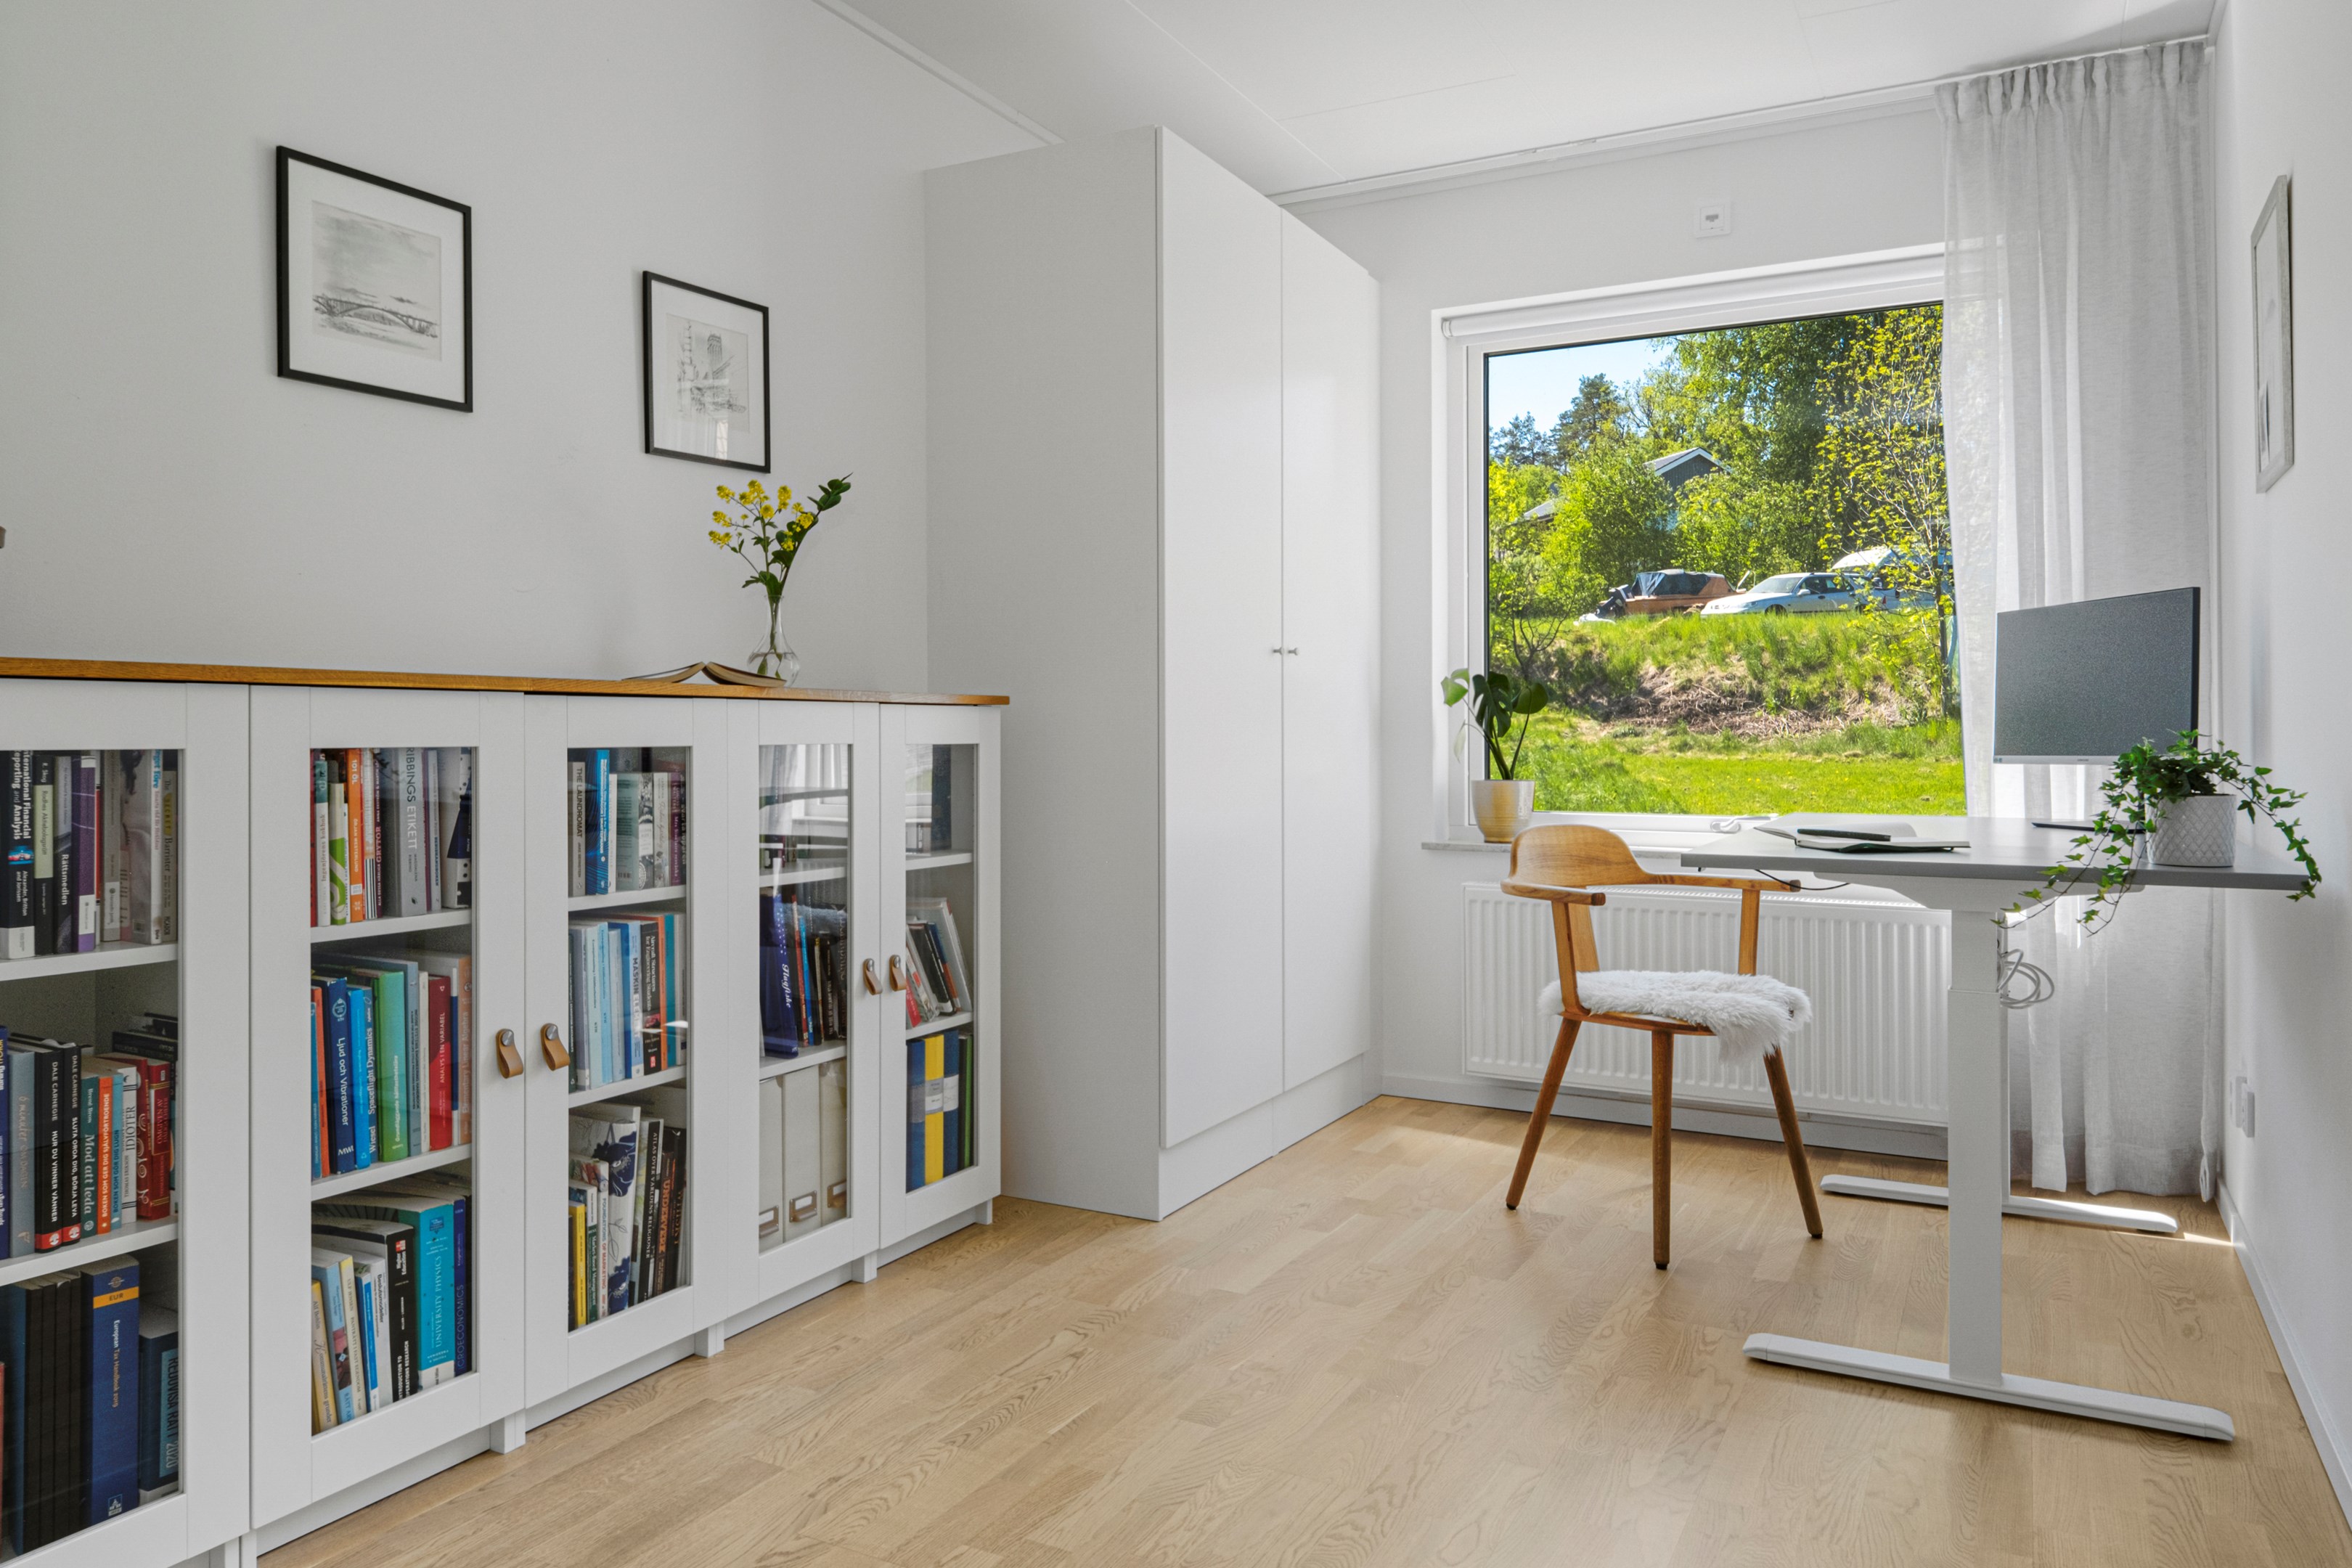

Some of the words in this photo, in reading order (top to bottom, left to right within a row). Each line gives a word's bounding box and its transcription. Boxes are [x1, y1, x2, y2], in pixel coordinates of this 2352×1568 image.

[12, 750, 23, 789] eporting
[407, 748, 416, 803] RIBBINGS
[12, 804, 23, 840] Analysis
[23, 802, 31, 839] Financial
[407, 805, 417, 849] ETIKETT
[164, 837, 173, 872] Barrister
[61, 854, 70, 906] Rättsmedlen
[781, 963, 792, 1008] Flugfiske
[336, 1037, 346, 1058] Ljud
[365, 1028, 375, 1068] Dynamics
[439, 1044, 445, 1053] EN
[339, 1077, 349, 1126] Vibrationer
[367, 1070, 377, 1115] Spaceflight
[125, 1106, 136, 1151] IDIOTER
[52, 1148, 58, 1159] DU
[85, 1133, 96, 1163] Mod
[85, 1164, 94, 1184] att
[84, 1186, 95, 1214] leda
[659, 1179, 671, 1254] UNDERVERK
[602, 1242, 607, 1251] OF
[109, 1292, 123, 1302] EUR
[113, 1319, 121, 1348] European
[322, 1400, 332, 1424] grunder
[166, 1441, 179, 1469] 2020
